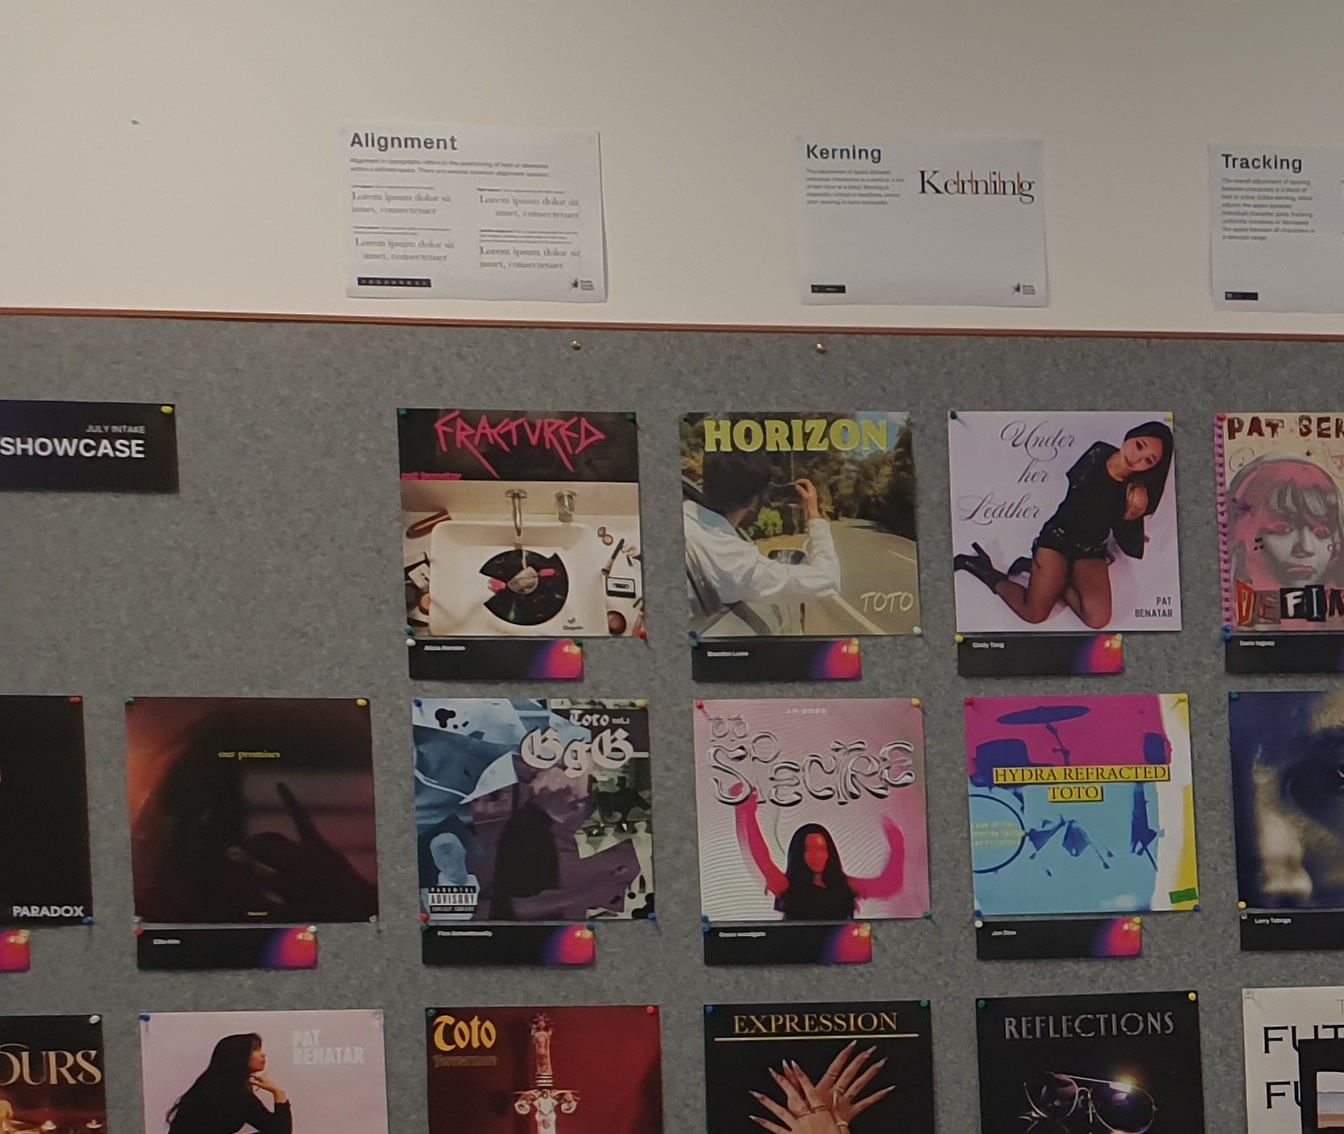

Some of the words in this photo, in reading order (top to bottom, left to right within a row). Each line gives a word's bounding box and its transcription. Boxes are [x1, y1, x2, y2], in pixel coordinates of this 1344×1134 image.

[350, 132, 458, 152] Alignment
[806, 144, 882, 164] Kerning
[1221, 154, 1303, 174] Tracking
[704, 418, 888, 452] HORIZON
[1227, 416, 1284, 440] PAT
[0, 436, 146, 458] SHOWCASE
[434, 410, 606, 479] FRACTURED
[1000, 420, 1077, 461] Under
[1017, 459, 1050, 484] her
[957, 492, 1041, 526] Leather
[860, 591, 914, 613] TOTO
[1156, 596, 1172, 606] PAT
[1134, 608, 1173, 618] BENATAR
[994, 767, 1058, 783] HYDRA
[1063, 765, 1166, 781] REFRACTED
[1049, 785, 1100, 800] TOTO
[12, 905, 85, 918] PARADOX
[433, 1014, 497, 1052] Toto
[734, 1012, 898, 1034] EXPRESSION
[1004, 1011, 1175, 1040] REFLECTIONS
[292, 1029, 320, 1046] PAT
[292, 1046, 364, 1065] BENATAR
